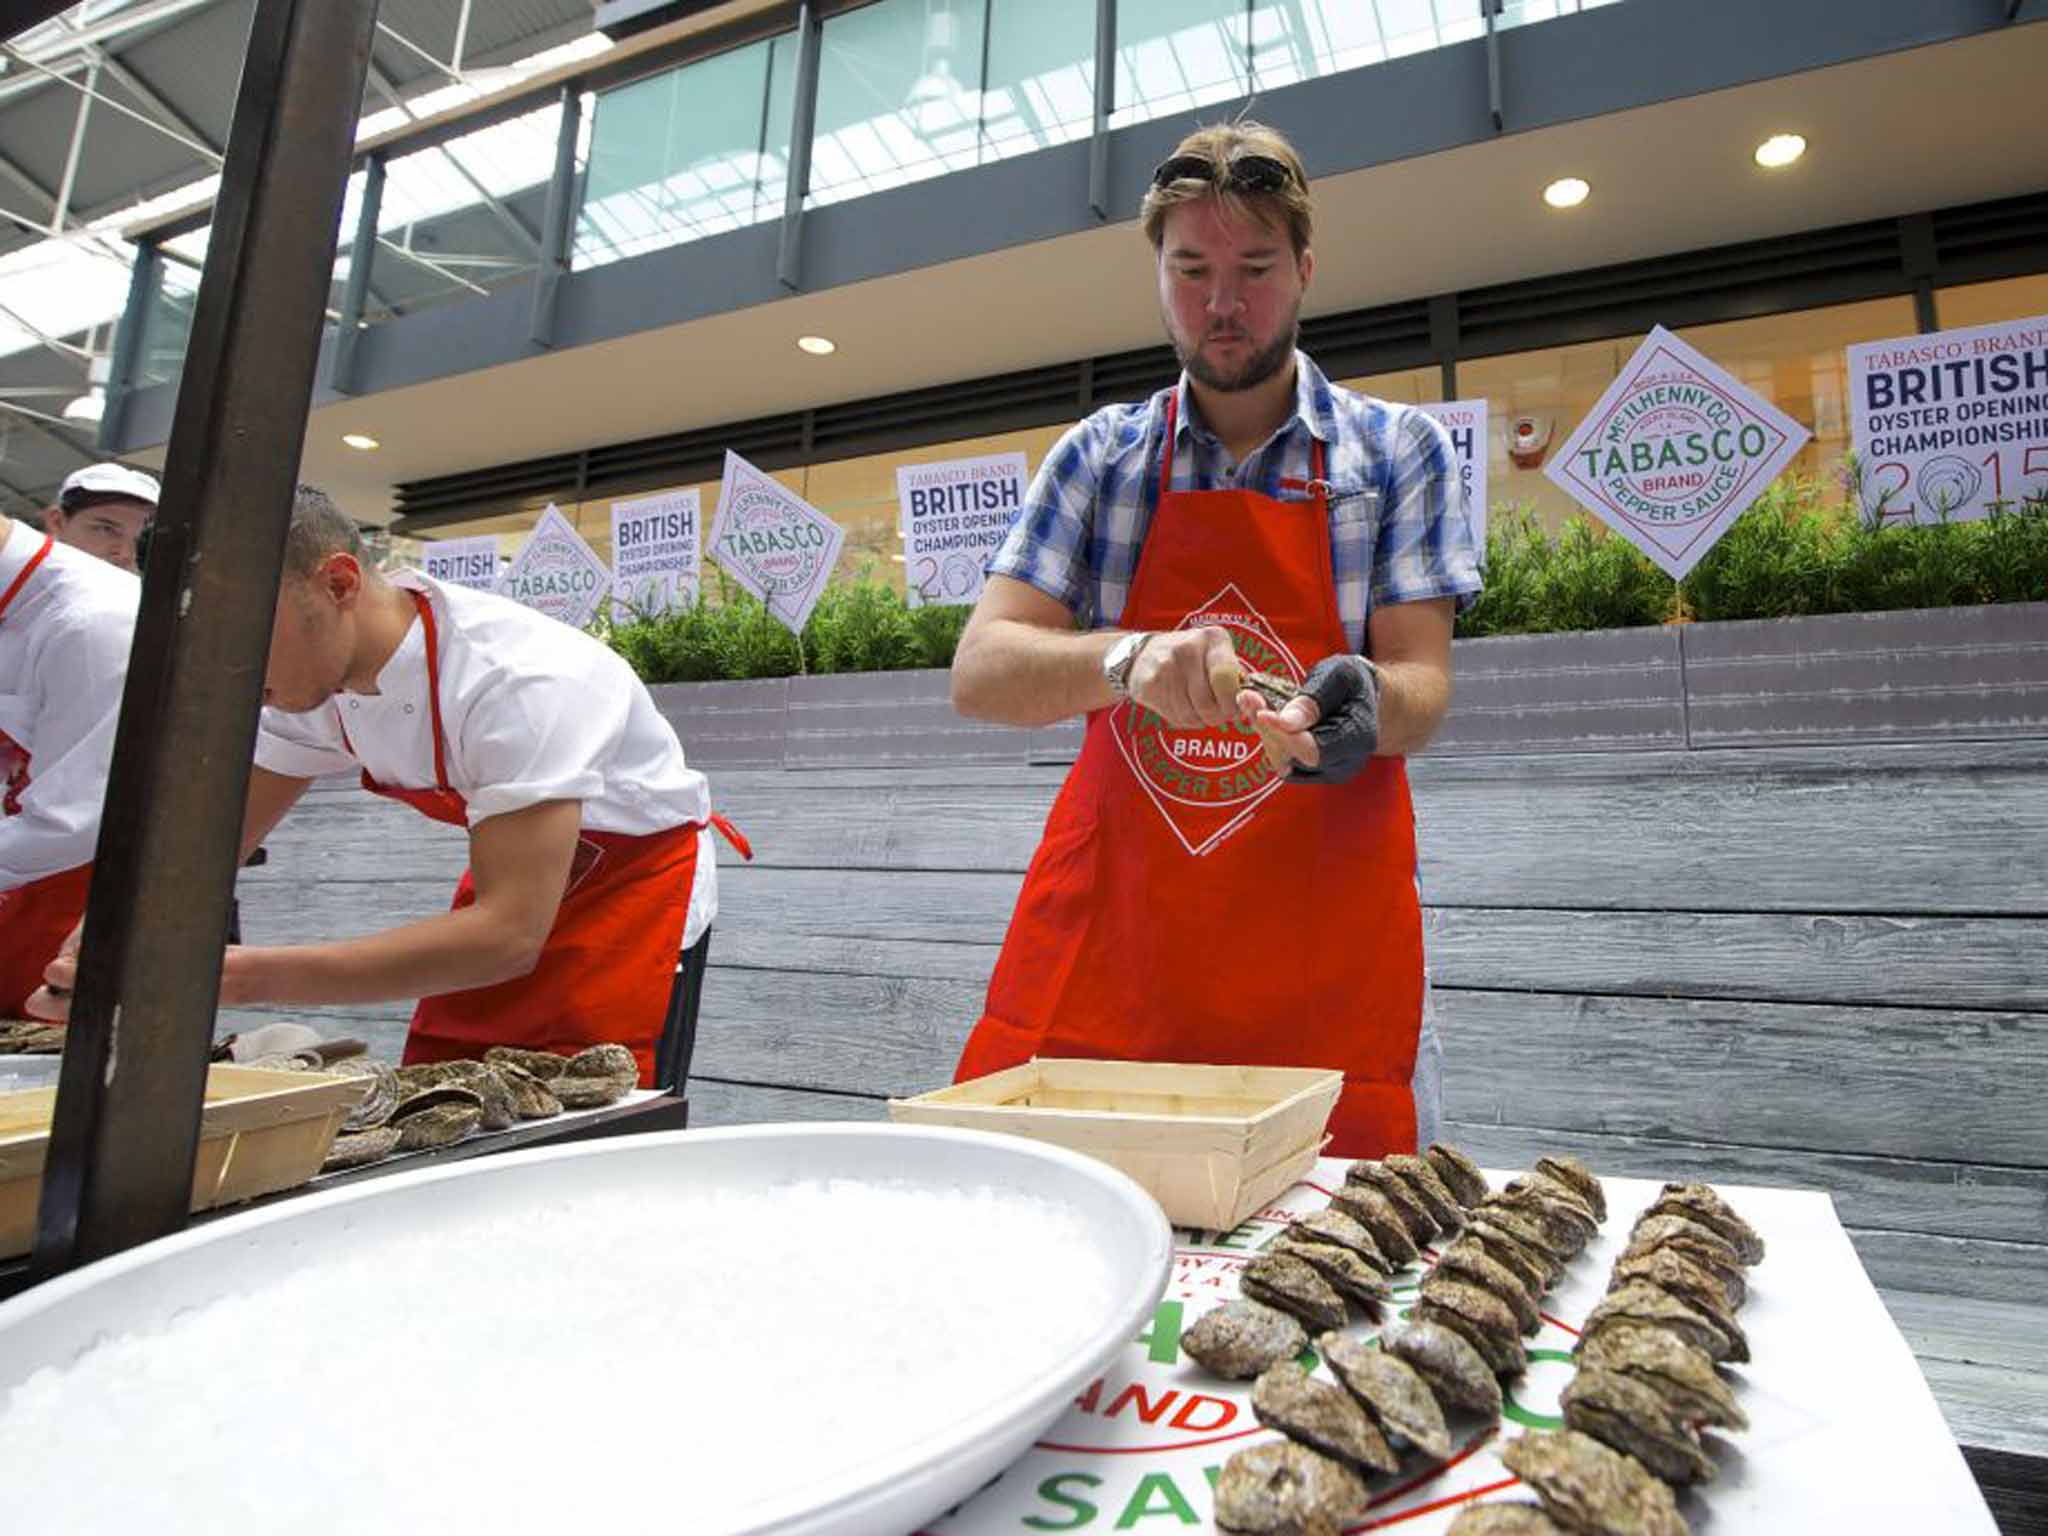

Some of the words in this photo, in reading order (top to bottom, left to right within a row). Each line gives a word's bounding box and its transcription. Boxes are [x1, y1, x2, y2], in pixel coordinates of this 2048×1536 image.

[1864, 343, 1962, 371] TABASCO
[1869, 406, 1950, 433] OYSTER
[1580, 424, 1765, 478] TABASCO
[911, 477, 1019, 518] BRITISH
[1608, 476, 1677, 521] PEPPER
[1682, 465, 1739, 518] SAUCE
[1642, 472, 1704, 493] BRAND
[618, 511, 694, 547] BRITISH
[720, 521, 824, 559] TABASCO
[913, 517, 960, 536] OYSTER
[506, 569, 596, 599] TABASCO
[1173, 738, 1249, 760] BRAND
